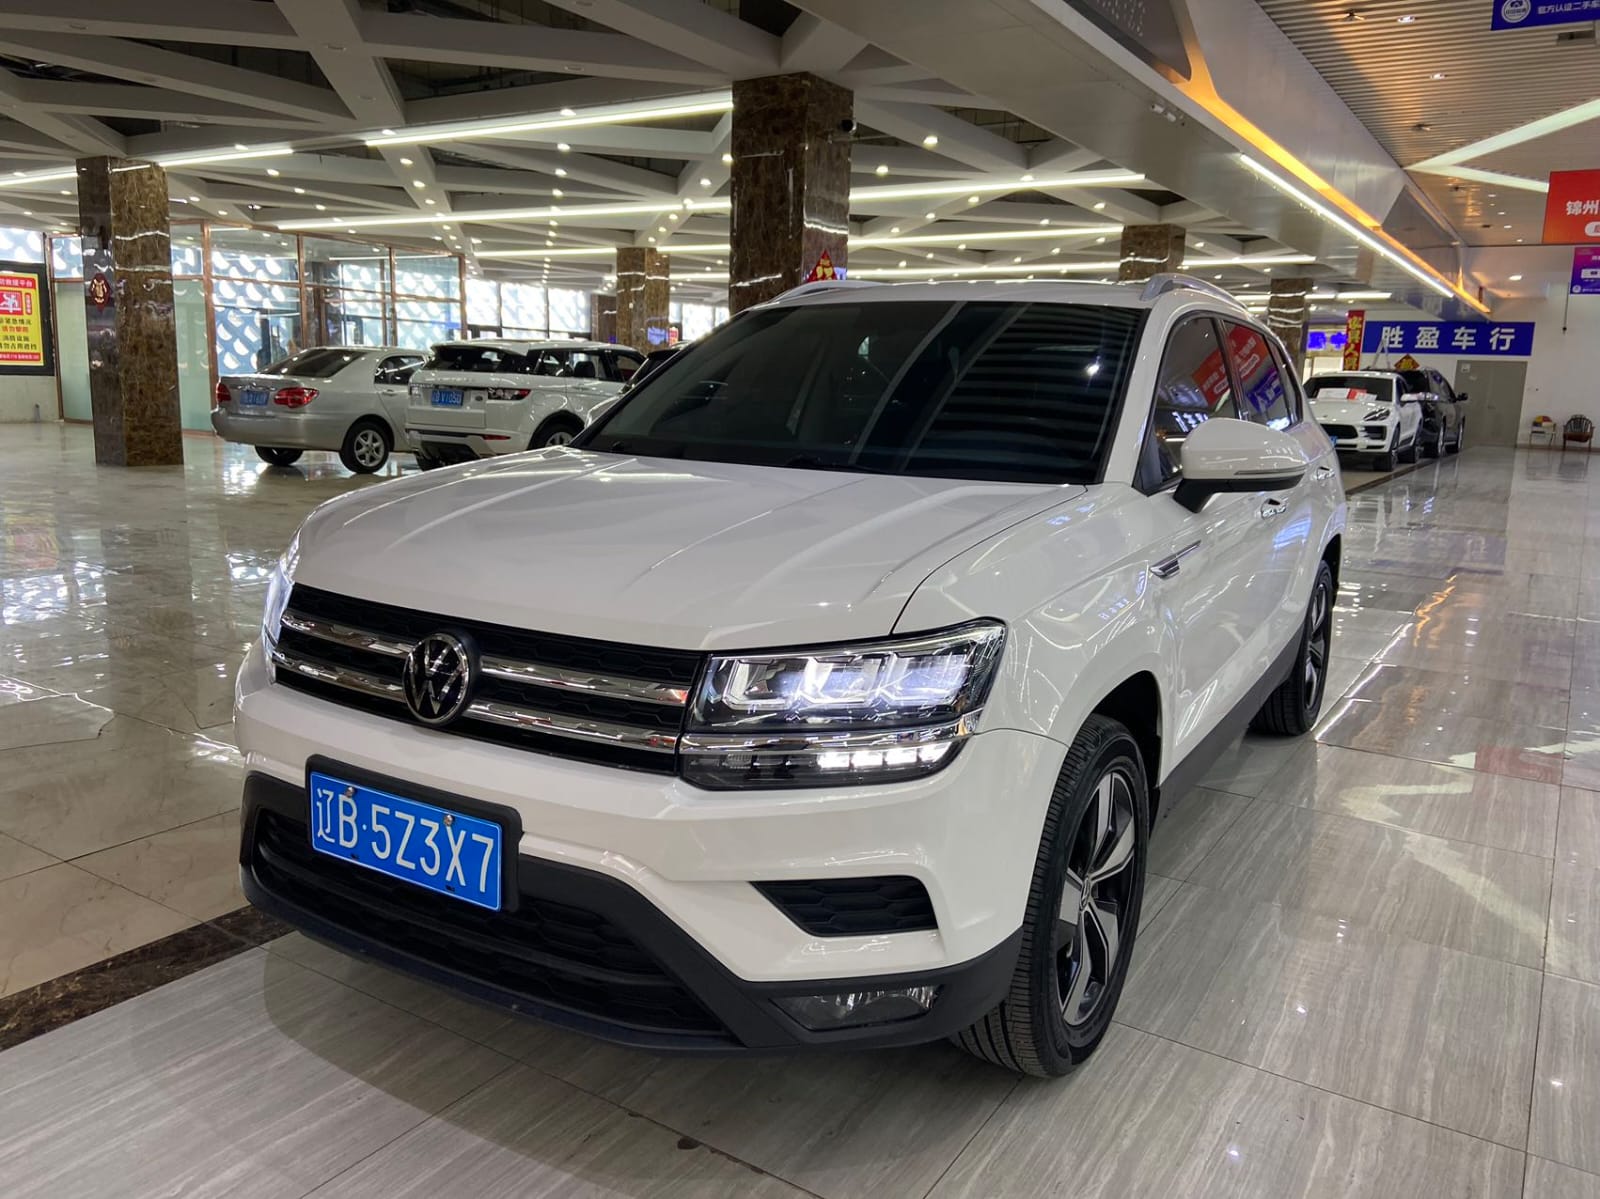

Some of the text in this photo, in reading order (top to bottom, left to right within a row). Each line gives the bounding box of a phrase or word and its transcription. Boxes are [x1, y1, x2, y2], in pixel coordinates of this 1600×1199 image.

[1566, 200, 1600, 216] 锦州
[1381, 326, 1515, 350] 胜盈车行
